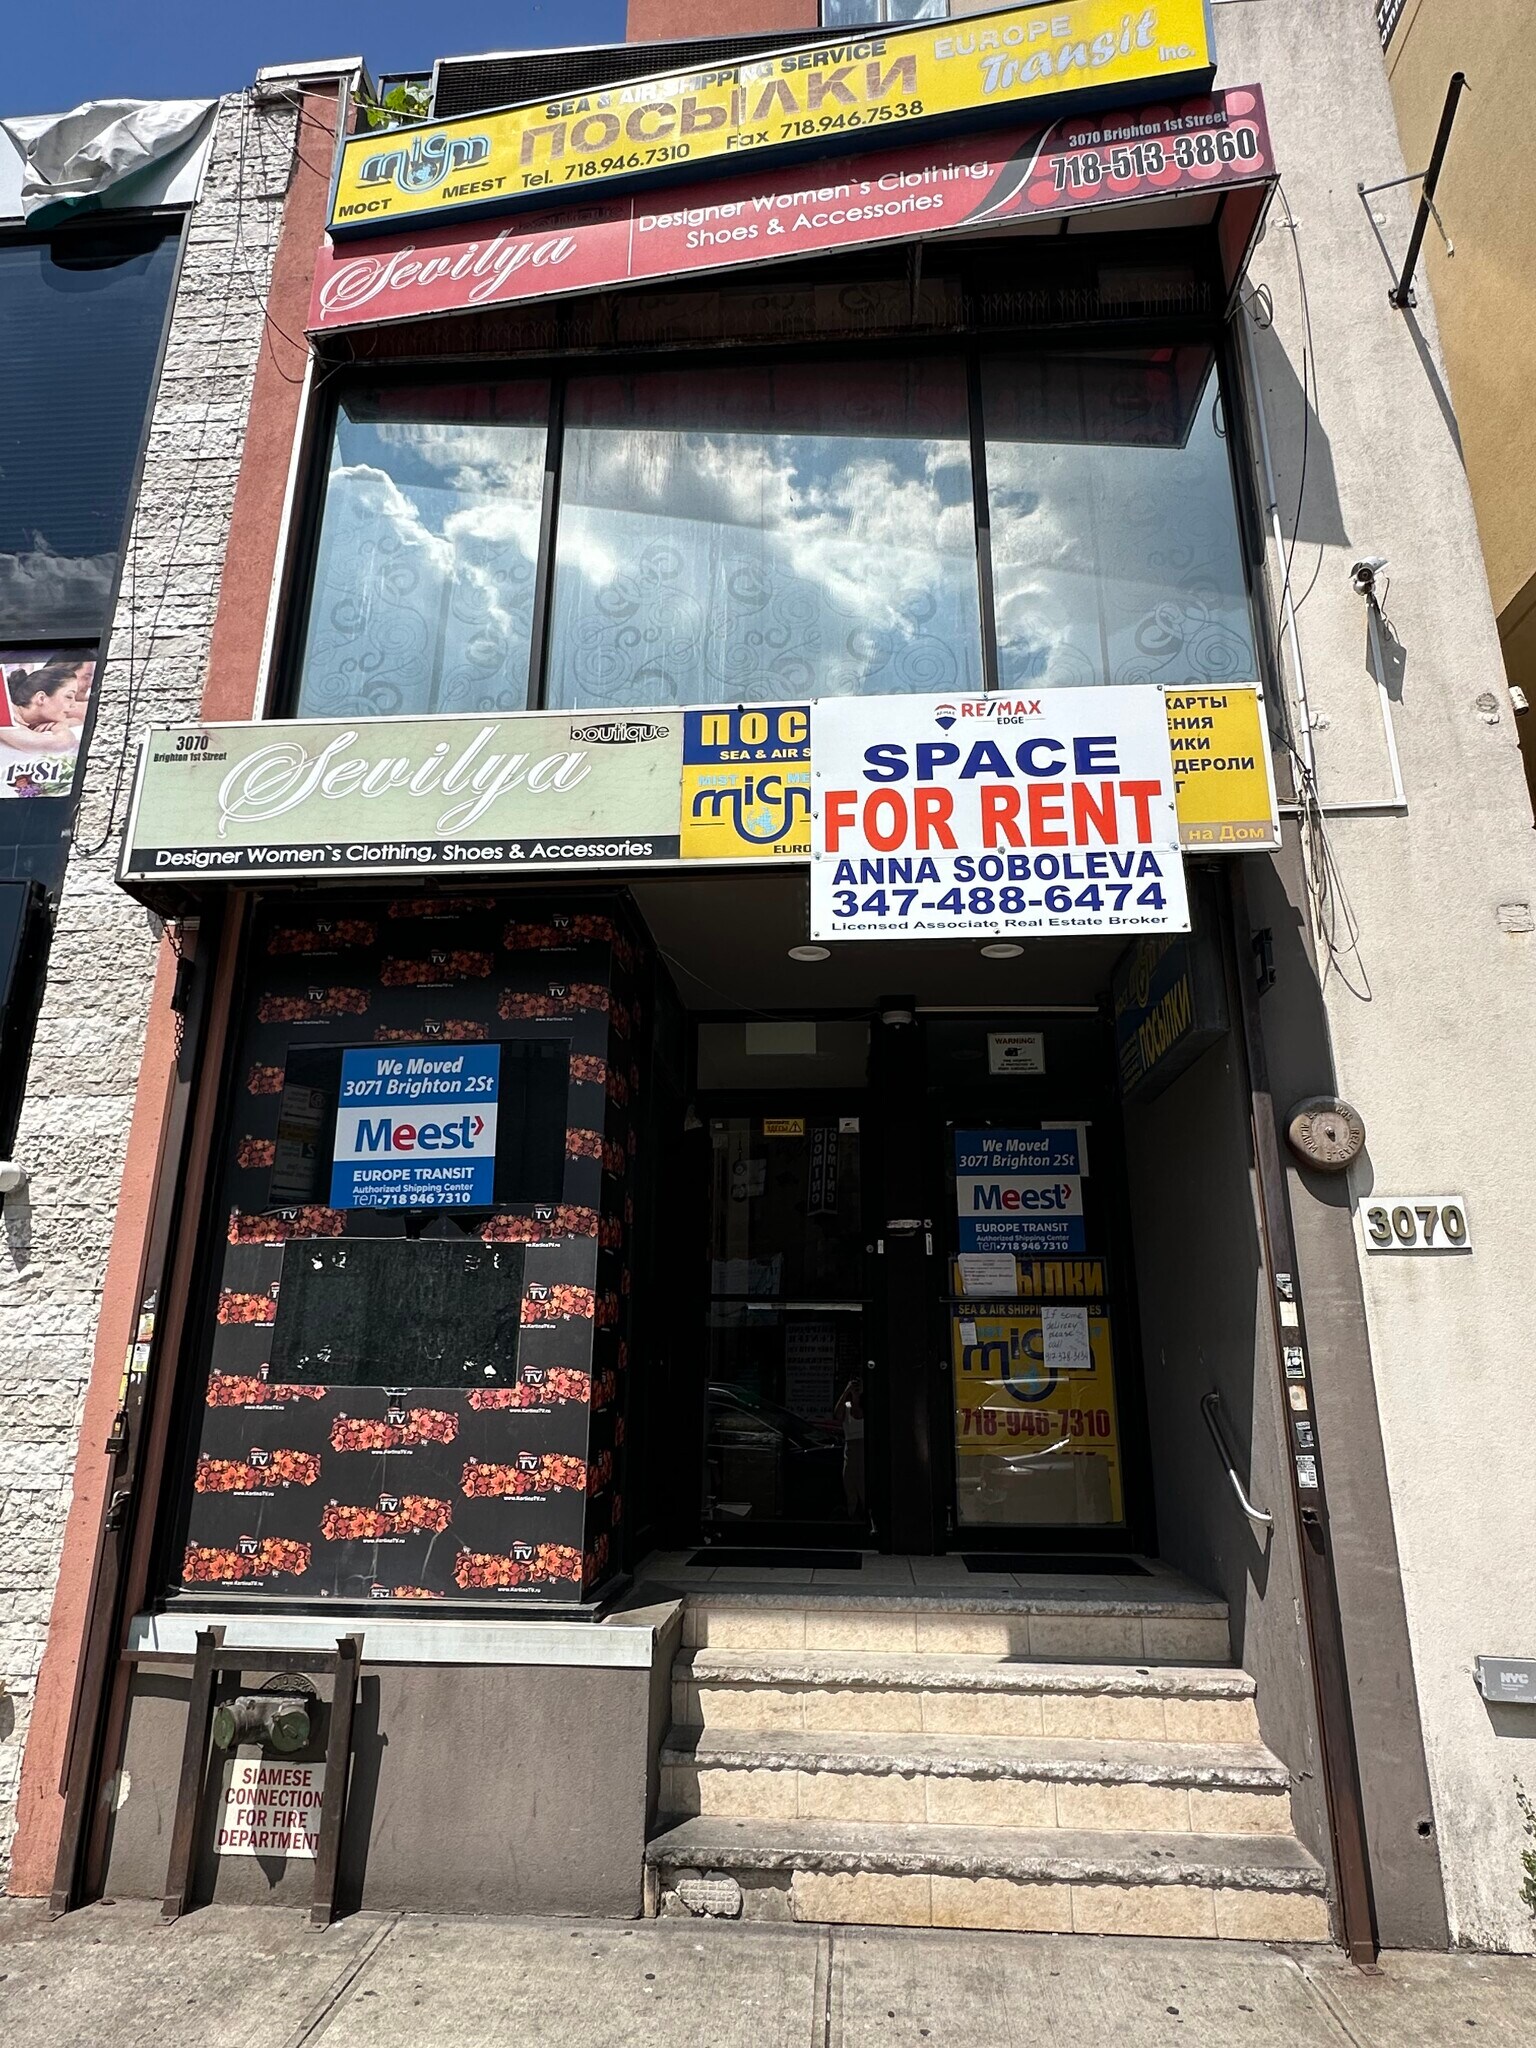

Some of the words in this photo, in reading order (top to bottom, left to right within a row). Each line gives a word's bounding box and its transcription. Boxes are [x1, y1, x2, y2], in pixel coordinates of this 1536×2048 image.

[934, 14, 1073, 60] EUROPE
[980, 9, 1157, 95] Transit
[1159, 43, 1195, 62] Inc.
[546, 97, 590, 120] SEA
[620, 82, 657, 106] AIR
[657, 62, 773, 99] SHIPPING
[781, 39, 887, 73] SERVICE
[519, 55, 918, 167] ПОСЫЛКИ
[1069, 133, 1101, 148] 3070
[1104, 122, 1161, 143] Brighton
[1164, 118, 1183, 132] 1st
[1185, 111, 1228, 130] Street
[522, 170, 553, 188] Tel.
[564, 143, 690, 180] 718.946.7310
[726, 130, 770, 150] Fax
[780, 100, 923, 140] 718.946.7538
[1051, 128, 1258, 191] 718-513-3860
[442, 176, 507, 199] MEEST
[639, 202, 746, 233] Designer
[878, 160, 994, 190] Clothing,
[686, 225, 758, 249] Shoes
[766, 218, 785, 235] &
[793, 192, 944, 231] Accessories
[319, 227, 578, 320] Sevilya
[961, 700, 1041, 717] RE/MAX
[997, 716, 1024, 725] EDGE
[570, 722, 670, 745] boutique
[176, 736, 209, 751] 3070
[153, 753, 188, 763] Brighton
[190, 753, 201, 761] 1st
[202, 752, 227, 761] Street
[720, 750, 751, 761] SEA
[755, 749, 766, 760] &
[771, 748, 799, 759] AIR
[862, 735, 1121, 782] SPACE
[218, 725, 592, 838] Sevilya
[698, 774, 738, 787] MIST
[824, 786, 959, 853] FOR
[980, 780, 1163, 849] RENT
[1188, 828, 1214, 841] на
[1219, 825, 1265, 842] Дом
[156, 850, 242, 867] Designer
[346, 844, 437, 862] Clothing,
[442, 844, 503, 862] Shoes
[509, 844, 527, 860] &
[529, 839, 653, 860] Accessories
[832, 856, 940, 886] ANNA
[953, 851, 1163, 883] SOBOLEVA
[832, 883, 1167, 917] 347-488-6474
[554, 919, 569, 928] TV
[832, 921, 908, 931] Licensed
[913, 919, 999, 931] Associate
[1005, 918, 1043, 928] Real
[1048, 917, 1103, 927] Estate
[1108, 915, 1169, 926] Broker
[431, 955, 447, 963] TV
[308, 991, 324, 1000] TV
[549, 988, 565, 997] TV
[425, 1024, 440, 1033] TV
[376, 1059, 403, 1076] We
[405, 1056, 463, 1075] Moved
[344, 1080, 382, 1096] 3071
[386, 1077, 460, 1098] Brighton
[464, 1076, 494, 1092] 2St
[355, 1115, 480, 1152] Meest
[982, 1139, 1003, 1152] We
[1005, 1138, 1049, 1152] Moved
[959, 1155, 988, 1167] 3071
[992, 1154, 1050, 1169] Brighton
[1053, 1154, 1075, 1166] 2St
[353, 1168, 411, 1182] EUROPE
[414, 1167, 474, 1180] TRANSIT
[353, 1184, 401, 1194] Authorized
[403, 1183, 442, 1194] Shipping
[444, 1182, 473, 1192] Center
[408, 1192, 435, 1204] 946
[437, 1191, 471, 1204] 7310
[973, 1184, 1068, 1210] Meest
[281, 1211, 298, 1220] TV
[536, 1211, 552, 1219] TV
[975, 1223, 1020, 1233] EUROPE
[1022, 1222, 1068, 1232] TRANSIT
[1367, 1205, 1466, 1242] 3070
[1022, 1242, 1041, 1250] 946
[1042, 1242, 1068, 1250] 7310
[530, 1290, 548, 1300] TV
[959, 1304, 976, 1315] SEA
[979, 1305, 986, 1315] &
[988, 1304, 1006, 1315] AIR
[524, 1373, 543, 1382] TV
[388, 1415, 405, 1424] TV
[961, 1408, 1110, 1437] 718-946-7310
[251, 1456, 269, 1465] TV
[520, 1459, 538, 1469] TV
[380, 1501, 398, 1511] TV
[240, 1544, 258, 1553] TV
[514, 1549, 533, 1559] TV
[1500, 1671, 1529, 1684] NYC
[242, 1768, 312, 1787] SIAMESE
[225, 1788, 324, 1808] CONNECTION
[237, 1809, 267, 1827] FOR
[273, 1811, 308, 1829] FIRE
[218, 1829, 320, 1850] DEPARTMENT
